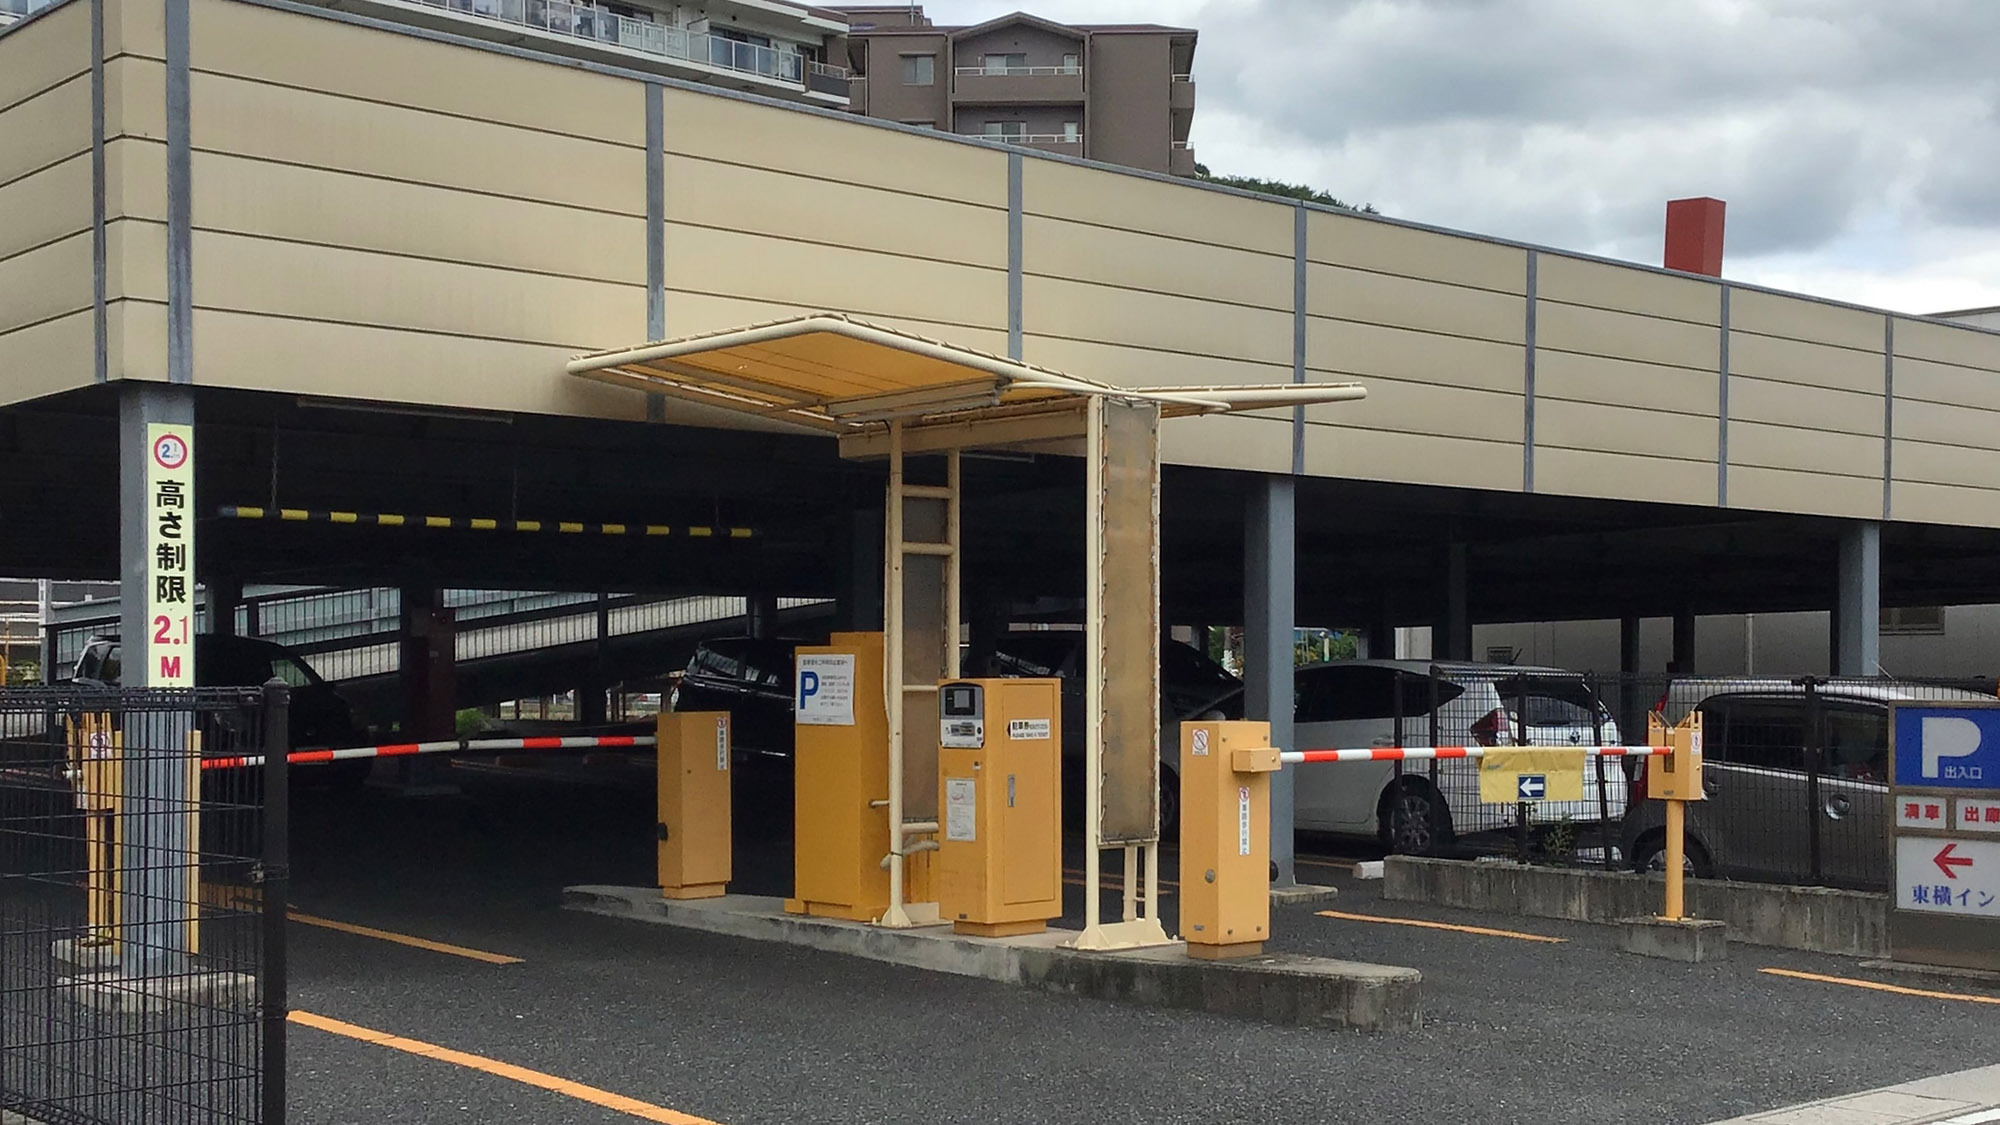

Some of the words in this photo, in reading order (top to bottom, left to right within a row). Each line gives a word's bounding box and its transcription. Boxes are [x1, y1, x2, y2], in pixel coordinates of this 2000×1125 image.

[156, 479, 186, 604] 高さ制限
[153, 614, 188, 645] 2.1
[161, 656, 181, 678] M
[799, 671, 819, 710] P
[1922, 716, 1981, 778] P
[1944, 765, 1983, 779] 出入口
[1904, 803, 1940, 820] 満車
